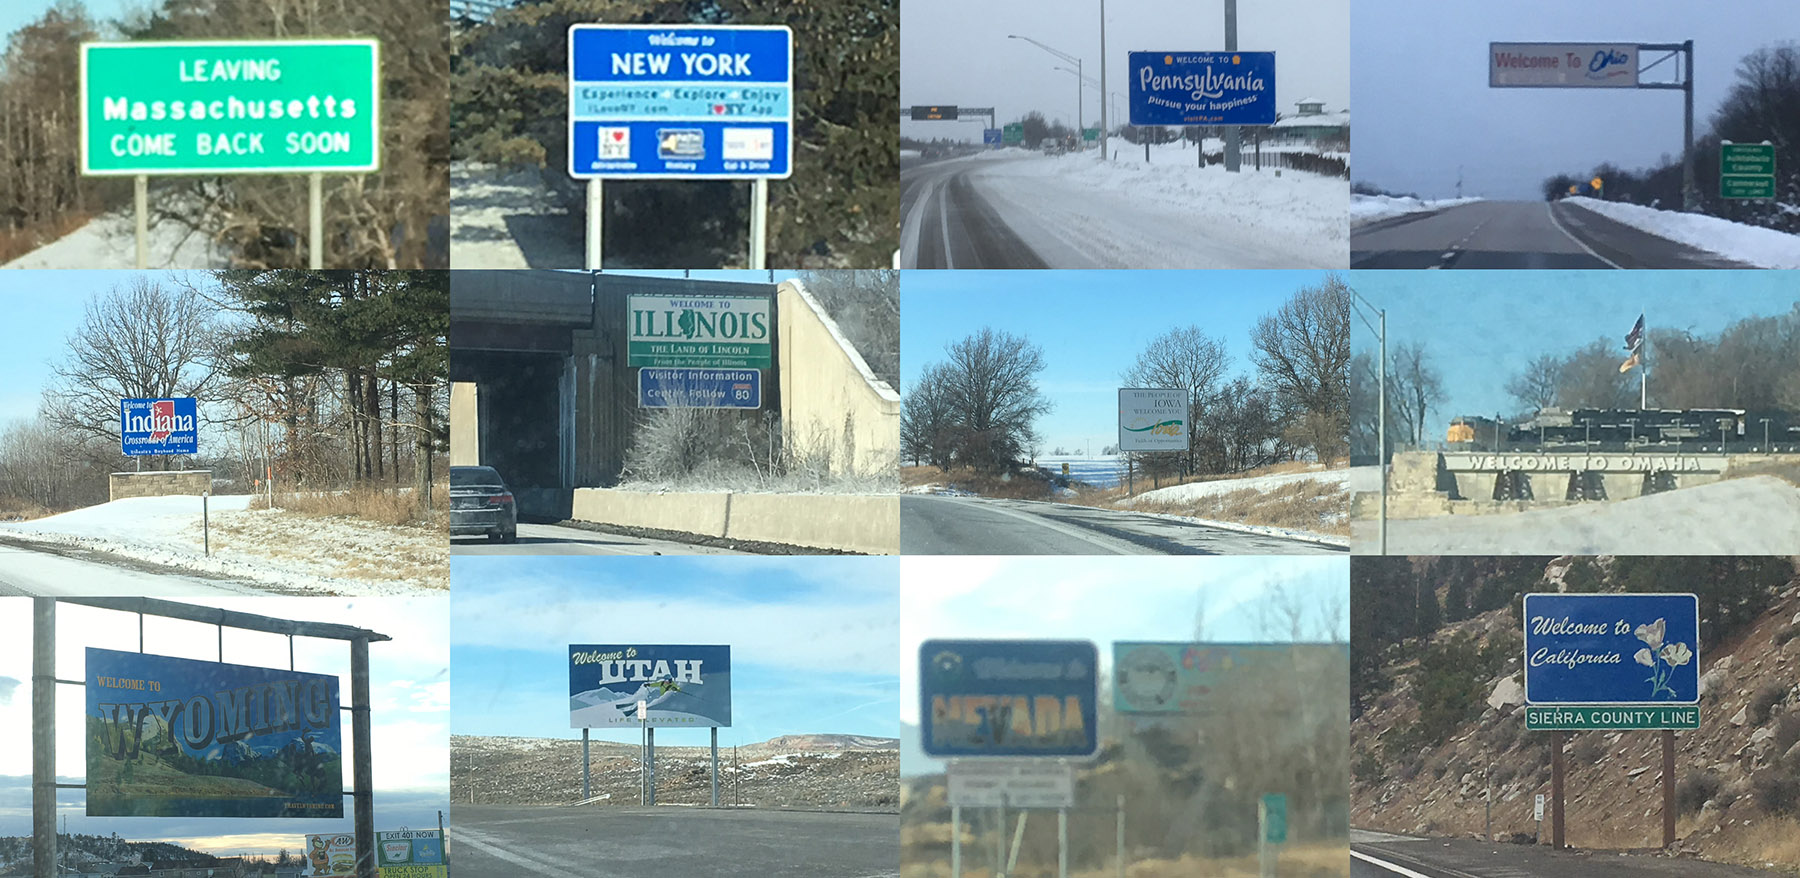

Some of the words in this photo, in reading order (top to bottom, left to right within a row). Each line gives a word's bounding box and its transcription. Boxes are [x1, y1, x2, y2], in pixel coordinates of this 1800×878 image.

[648, 32, 699, 47] Welcome
[701, 35, 715, 47] to
[611, 53, 671, 75] NEW
[681, 53, 751, 76] YORK
[1176, 56, 1214, 64] WELCOME
[1219, 56, 1229, 64] TO
[1495, 52, 1559, 69] Welcome
[1566, 53, 1582, 69] To
[1588, 48, 1629, 72] Ohio
[180, 59, 281, 82] LEAVING
[1140, 65, 1265, 101] Pennsylvania
[103, 95, 357, 121] Massachusetts
[1148, 95, 1181, 110] pursue
[1185, 102, 1206, 112] your
[1209, 94, 1258, 112] happiness
[110, 133, 177, 157] COME
[197, 132, 264, 155] BACK
[286, 131, 350, 154] SOON
[669, 300, 714, 308] WELCOME
[633, 309, 767, 340] ILLINOIS
[651, 345, 668, 353] THE
[670, 343, 696, 354] LAND
[698, 345, 708, 354] OF
[712, 345, 750, 355] LINCOLN
[654, 358, 672, 366] From
[674, 358, 686, 366] the
[687, 358, 714, 367] People
[715, 358, 722, 366] of
[722, 358, 747, 366] Illinois
[648, 371, 683, 379] Visitor
[688, 371, 752, 381] Information
[689, 389, 726, 398] Follow
[735, 390, 750, 400] 80
[123, 401, 145, 409] Welcome
[1154, 399, 1182, 408] IOWA
[123, 408, 194, 433] Indiana
[168, 434, 193, 444] America
[1467, 457, 1570, 472] WELCOME
[1577, 457, 1609, 472] TO
[1622, 456, 1701, 472] OMAHA
[1530, 615, 1608, 636] Welcome
[1614, 619, 1631, 636] to
[572, 650, 623, 665] Welcome
[626, 647, 638, 659] to
[1529, 647, 1622, 670] California
[598, 659, 704, 685] UTAH
[97, 675, 145, 691] WELCOME
[148, 680, 161, 692] TO
[98, 678, 333, 761] WYOMING
[1529, 711, 1586, 725] SIERRA
[1591, 711, 1655, 724] COUNTY
[1661, 711, 1696, 724] LINE
[402, 831, 413, 839] 401
[416, 830, 434, 838] NOW
[384, 866, 409, 874] TRUCK
[410, 865, 428, 873] STOP
